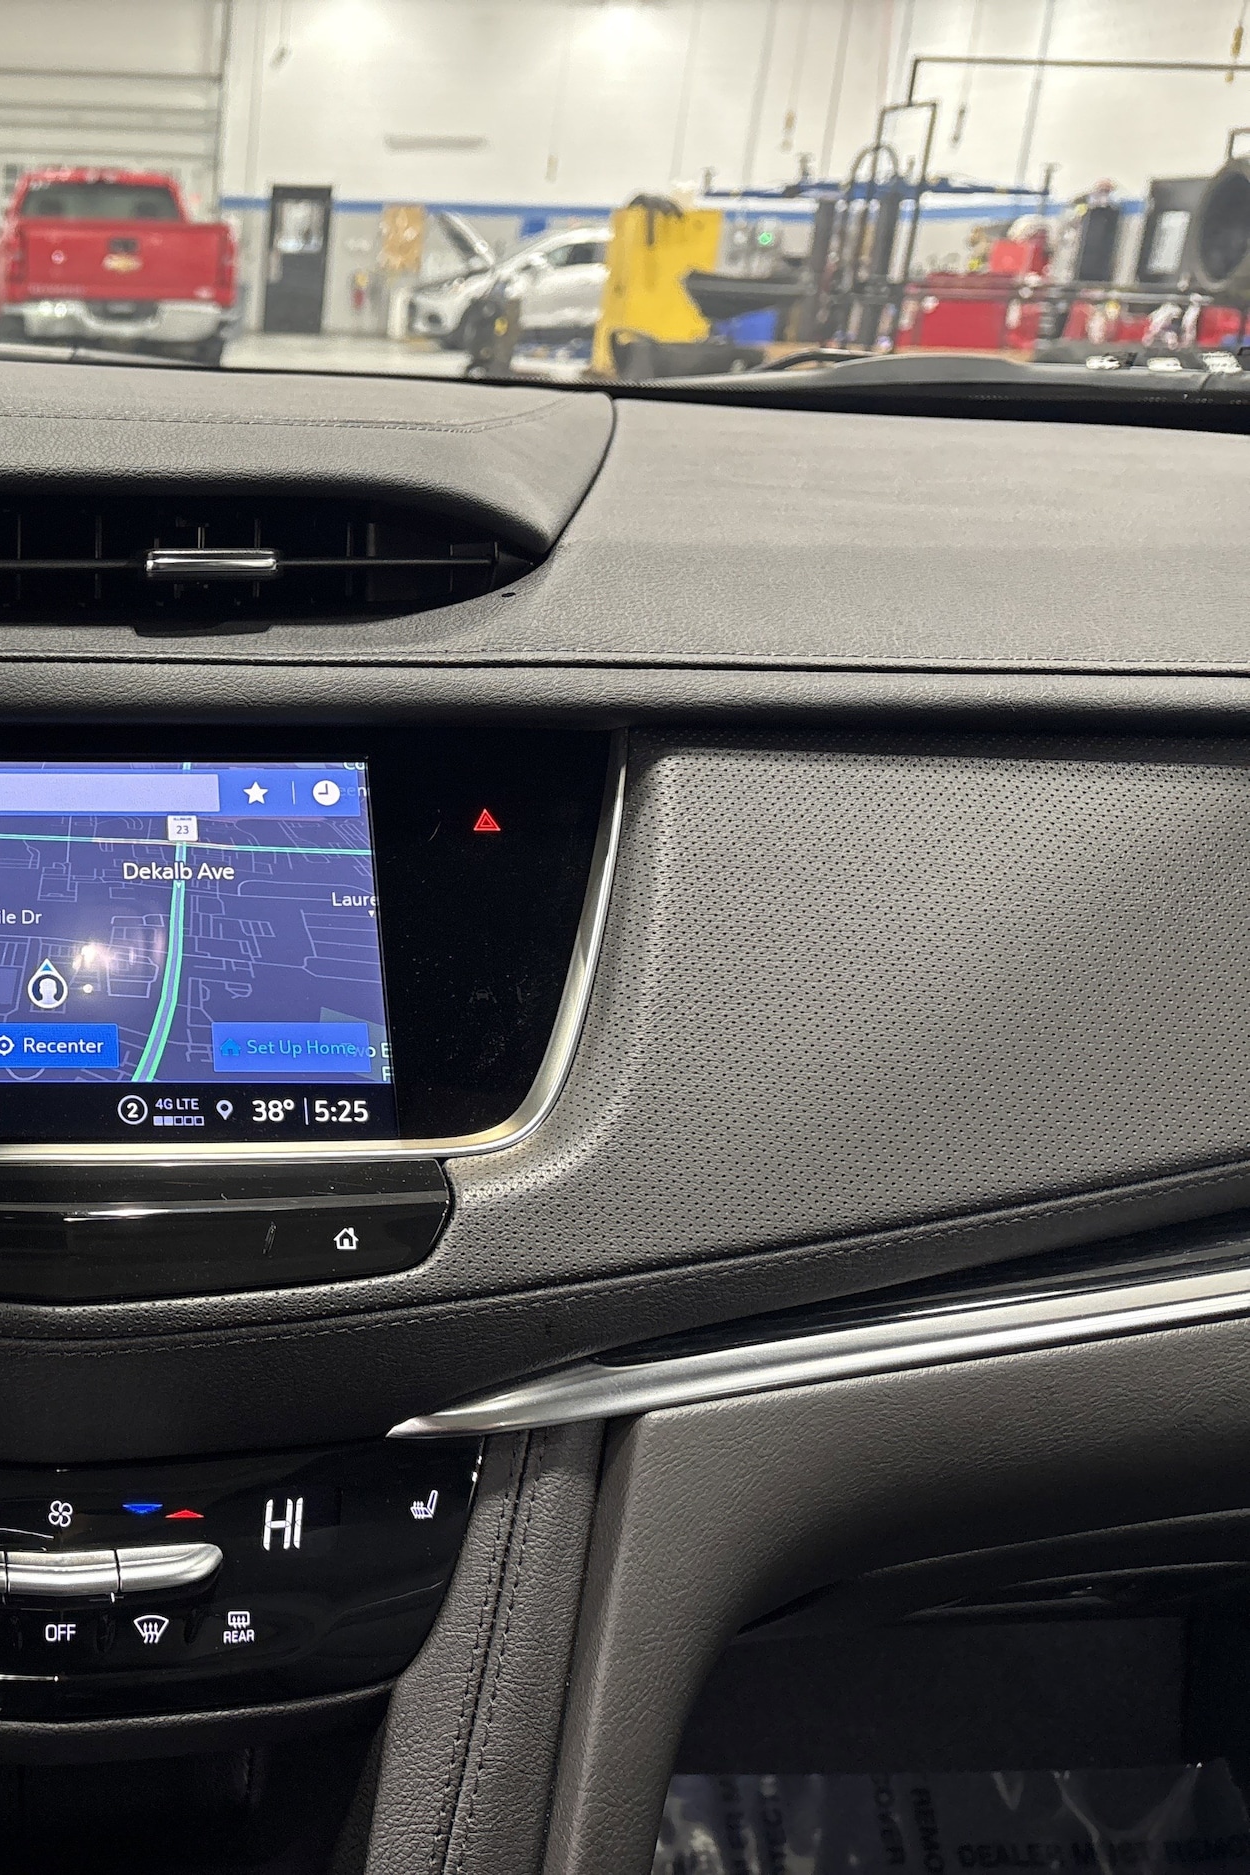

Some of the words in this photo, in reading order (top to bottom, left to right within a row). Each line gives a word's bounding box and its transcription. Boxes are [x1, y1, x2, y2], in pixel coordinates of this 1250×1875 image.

[176, 825, 190, 835] 23
[122, 861, 193, 881] Dekalb
[197, 864, 235, 881] Ave
[21, 909, 43, 925] Dr
[22, 1037, 104, 1054] Recenter
[246, 1039, 276, 1055] Set
[280, 1040, 303, 1058] Up
[307, 1040, 357, 1056] Home
[126, 1101, 139, 1119] 2
[154, 1098, 174, 1110] 4G
[175, 1099, 200, 1111] LTE
[313, 1100, 370, 1124] 5:25
[262, 1498, 304, 1551] HI
[44, 1623, 77, 1643] OFF
[222, 1629, 256, 1645] REAR
